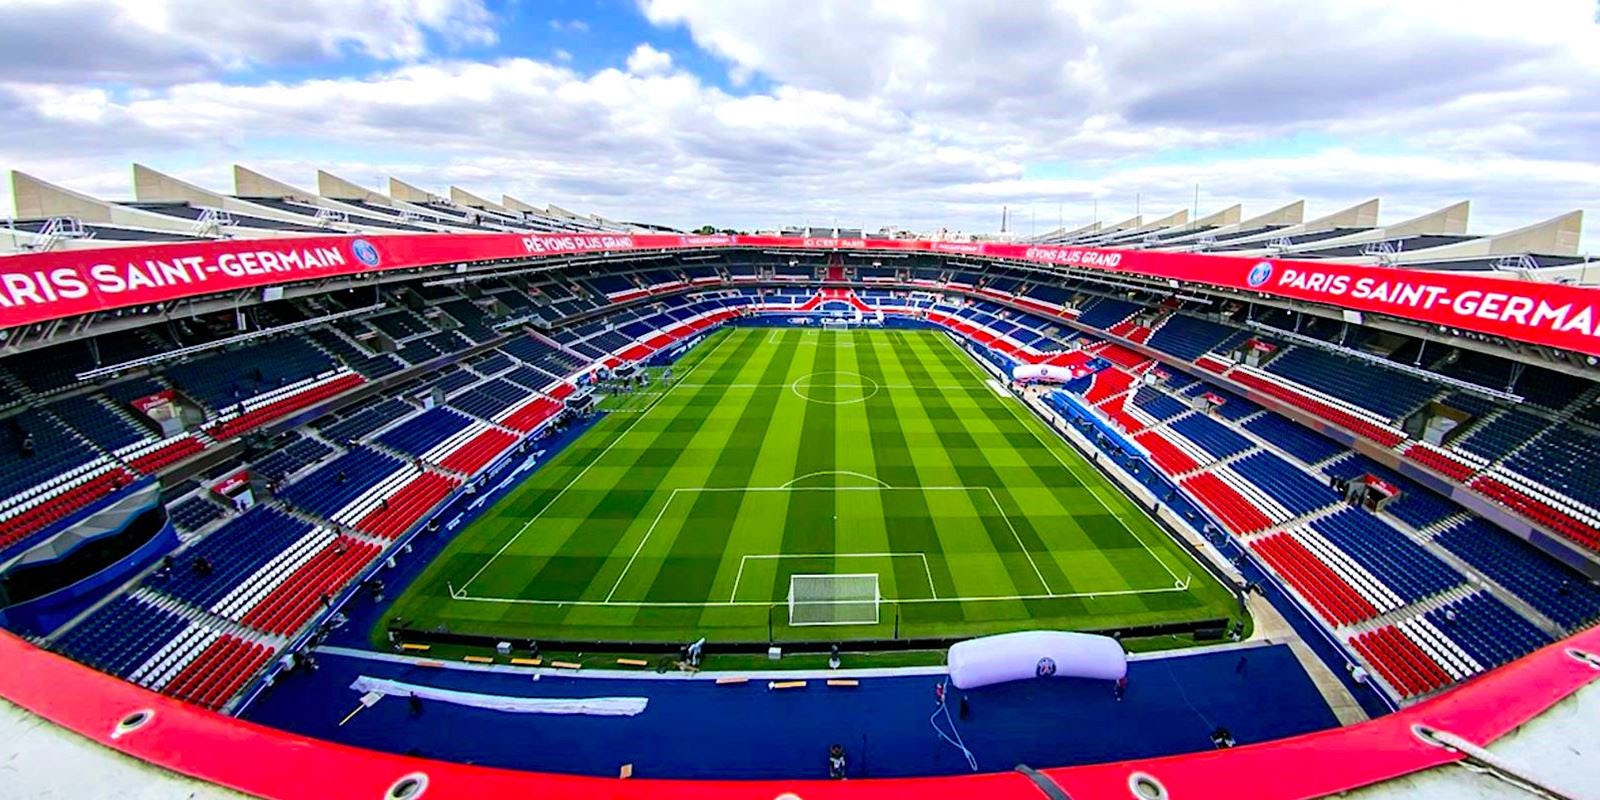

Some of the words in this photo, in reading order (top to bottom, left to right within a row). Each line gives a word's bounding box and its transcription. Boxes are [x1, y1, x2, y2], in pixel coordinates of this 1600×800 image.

[574, 236, 603, 250] PLUS
[602, 236, 633, 249] GRAND
[1057, 249, 1081, 262] PLUS
[1082, 252, 1122, 268] GRAND
[90, 246, 346, 294] SAINT-GERMAIN
[1278, 269, 1352, 295] PARIS
